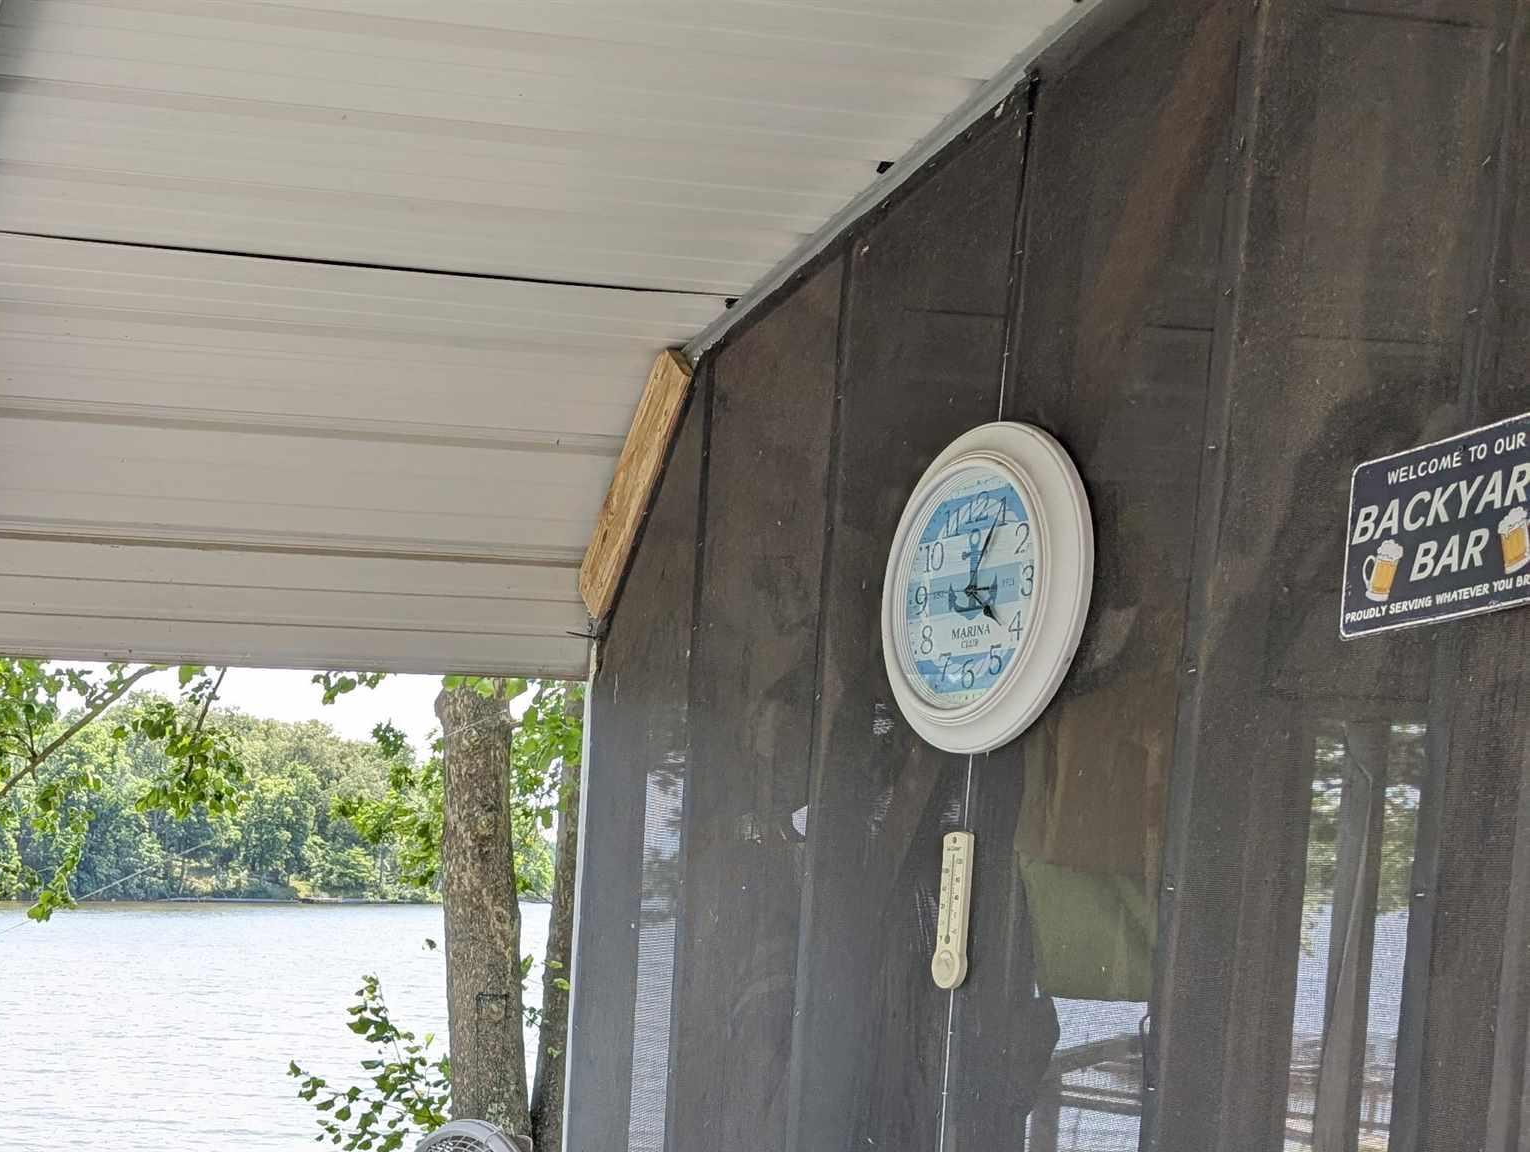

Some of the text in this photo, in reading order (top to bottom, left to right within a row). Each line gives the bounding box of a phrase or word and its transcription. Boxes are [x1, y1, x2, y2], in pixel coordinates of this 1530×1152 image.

[1387, 432, 1527, 485] WELCOME TO OUR
[942, 506, 961, 539] 11
[965, 490, 990, 525] 12
[1014, 522, 1030, 555] 2
[923, 541, 944, 573] 10
[1409, 528, 1490, 582] BAR
[1021, 564, 1034, 597] 3
[915, 586, 928, 615] 9
[1344, 603, 1388, 624] PROUDLY
[1389, 595, 1433, 615] SERVING
[1435, 582, 1490, 605] WHATEVER
[1492, 576, 1513, 593] YOU
[920, 625, 933, 655] 8
[951, 623, 991, 641] MARINA
[1008, 609, 1023, 641] 4
[940, 652, 952, 682] 7
[961, 659, 974, 689] 6
[989, 643, 1002, 675] 5
